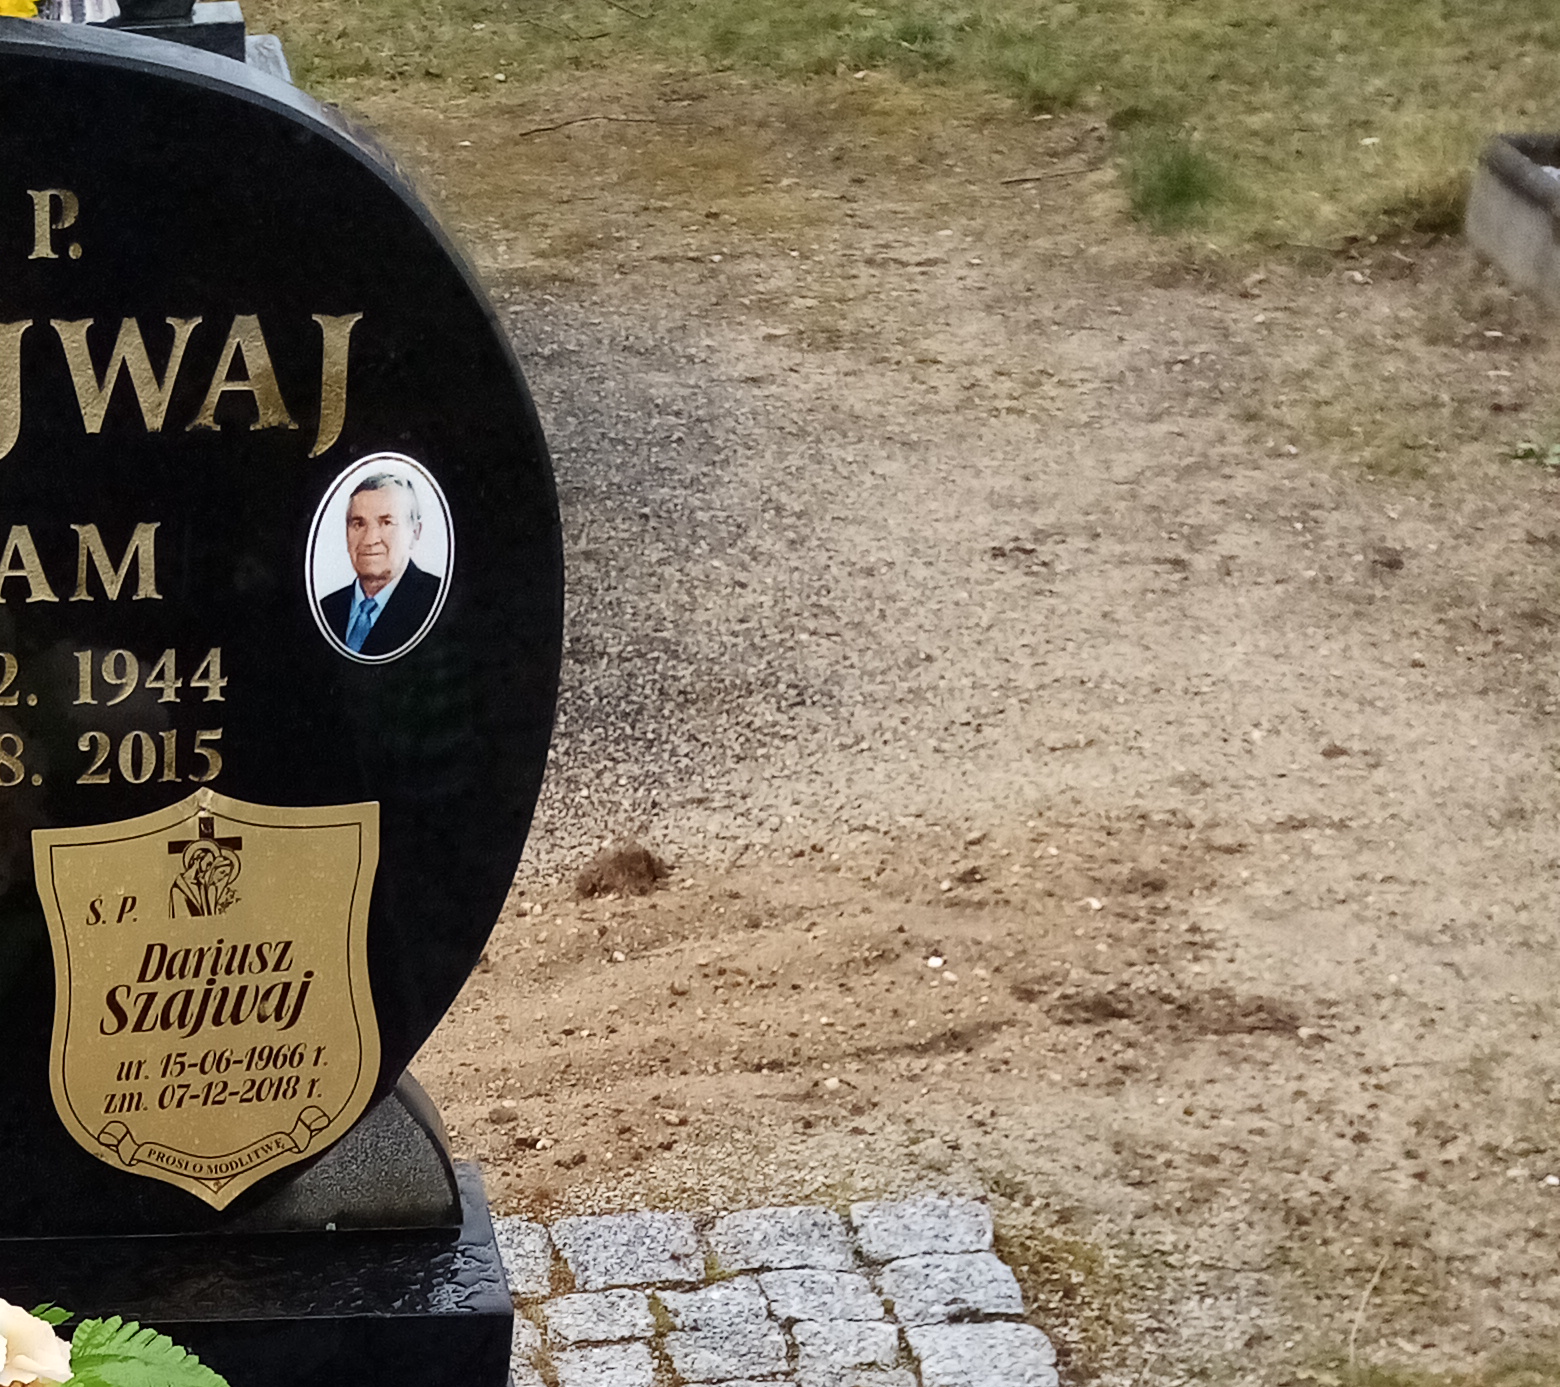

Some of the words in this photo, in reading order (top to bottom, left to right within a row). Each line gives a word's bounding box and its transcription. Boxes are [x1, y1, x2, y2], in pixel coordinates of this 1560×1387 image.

[26, 188, 84, 262] P.
[72, 648, 229, 706] 1944
[76, 727, 225, 786] 2015
[116, 895, 138, 924] P.
[136, 938, 295, 984] Dariusz
[99, 970, 315, 1039] Szajwaj
[115, 1056, 150, 1083] ur.
[159, 1042, 307, 1080] 15-06-1966
[313, 1043, 329, 1068] r.
[103, 1087, 149, 1115] zm.
[157, 1075, 300, 1111] 07-12-2018
[307, 1074, 323, 1099] r.
[146, 1147, 190, 1171] PROSI
[192, 1162, 204, 1174] O
[206, 1137, 287, 1175] MODLITWĘ
